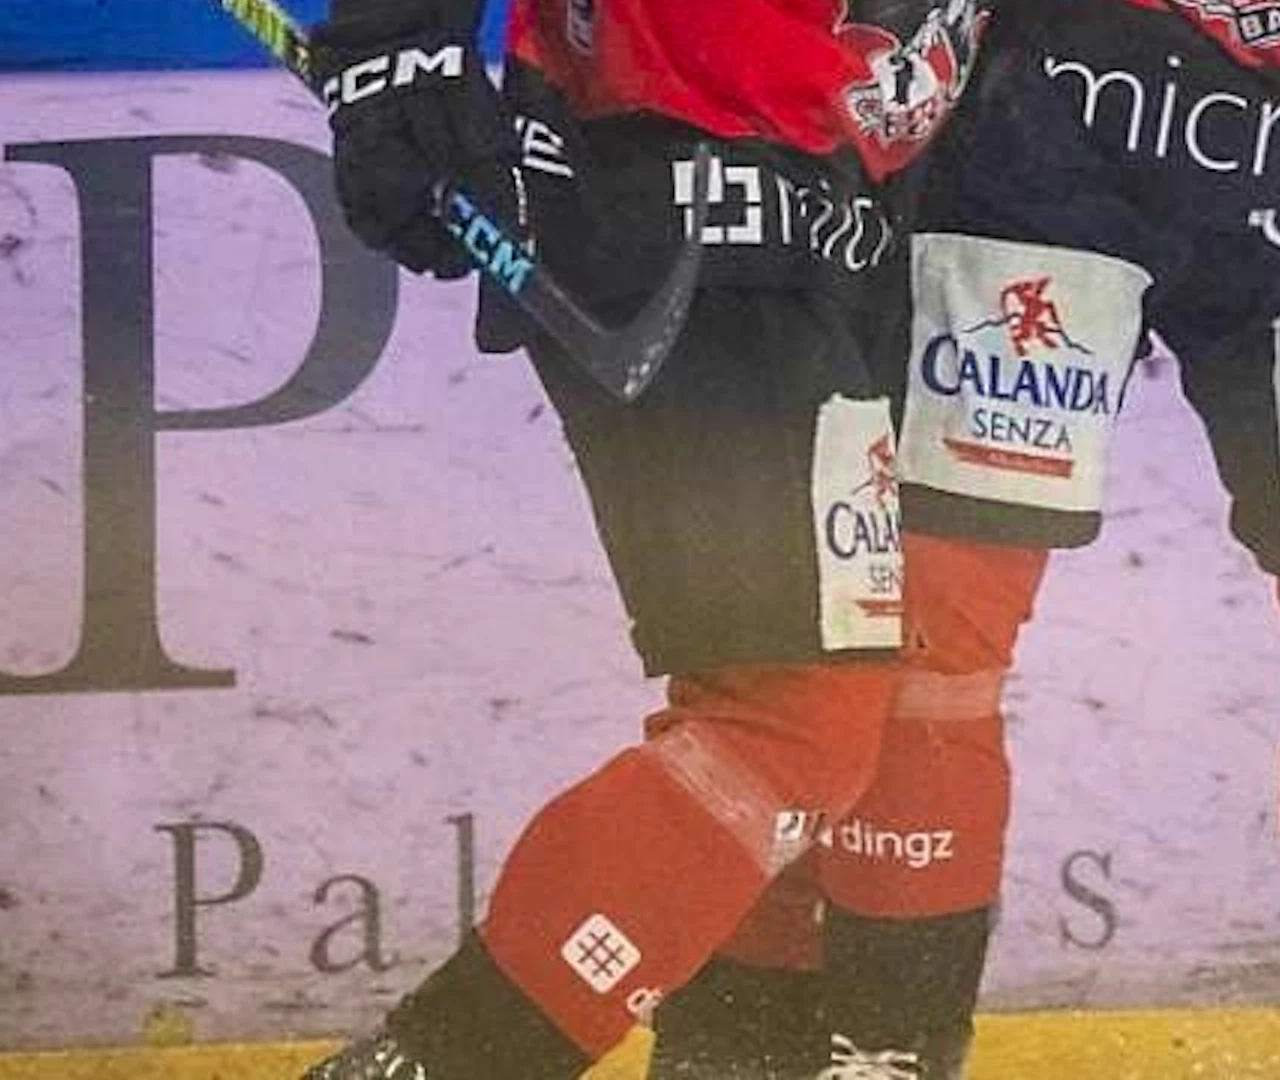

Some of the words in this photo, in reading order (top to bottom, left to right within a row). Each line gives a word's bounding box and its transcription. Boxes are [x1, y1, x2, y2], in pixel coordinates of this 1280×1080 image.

[922, 333, 1111, 416] CALANDA
[972, 407, 1073, 451] SENZA
[841, 821, 954, 868] dingz
